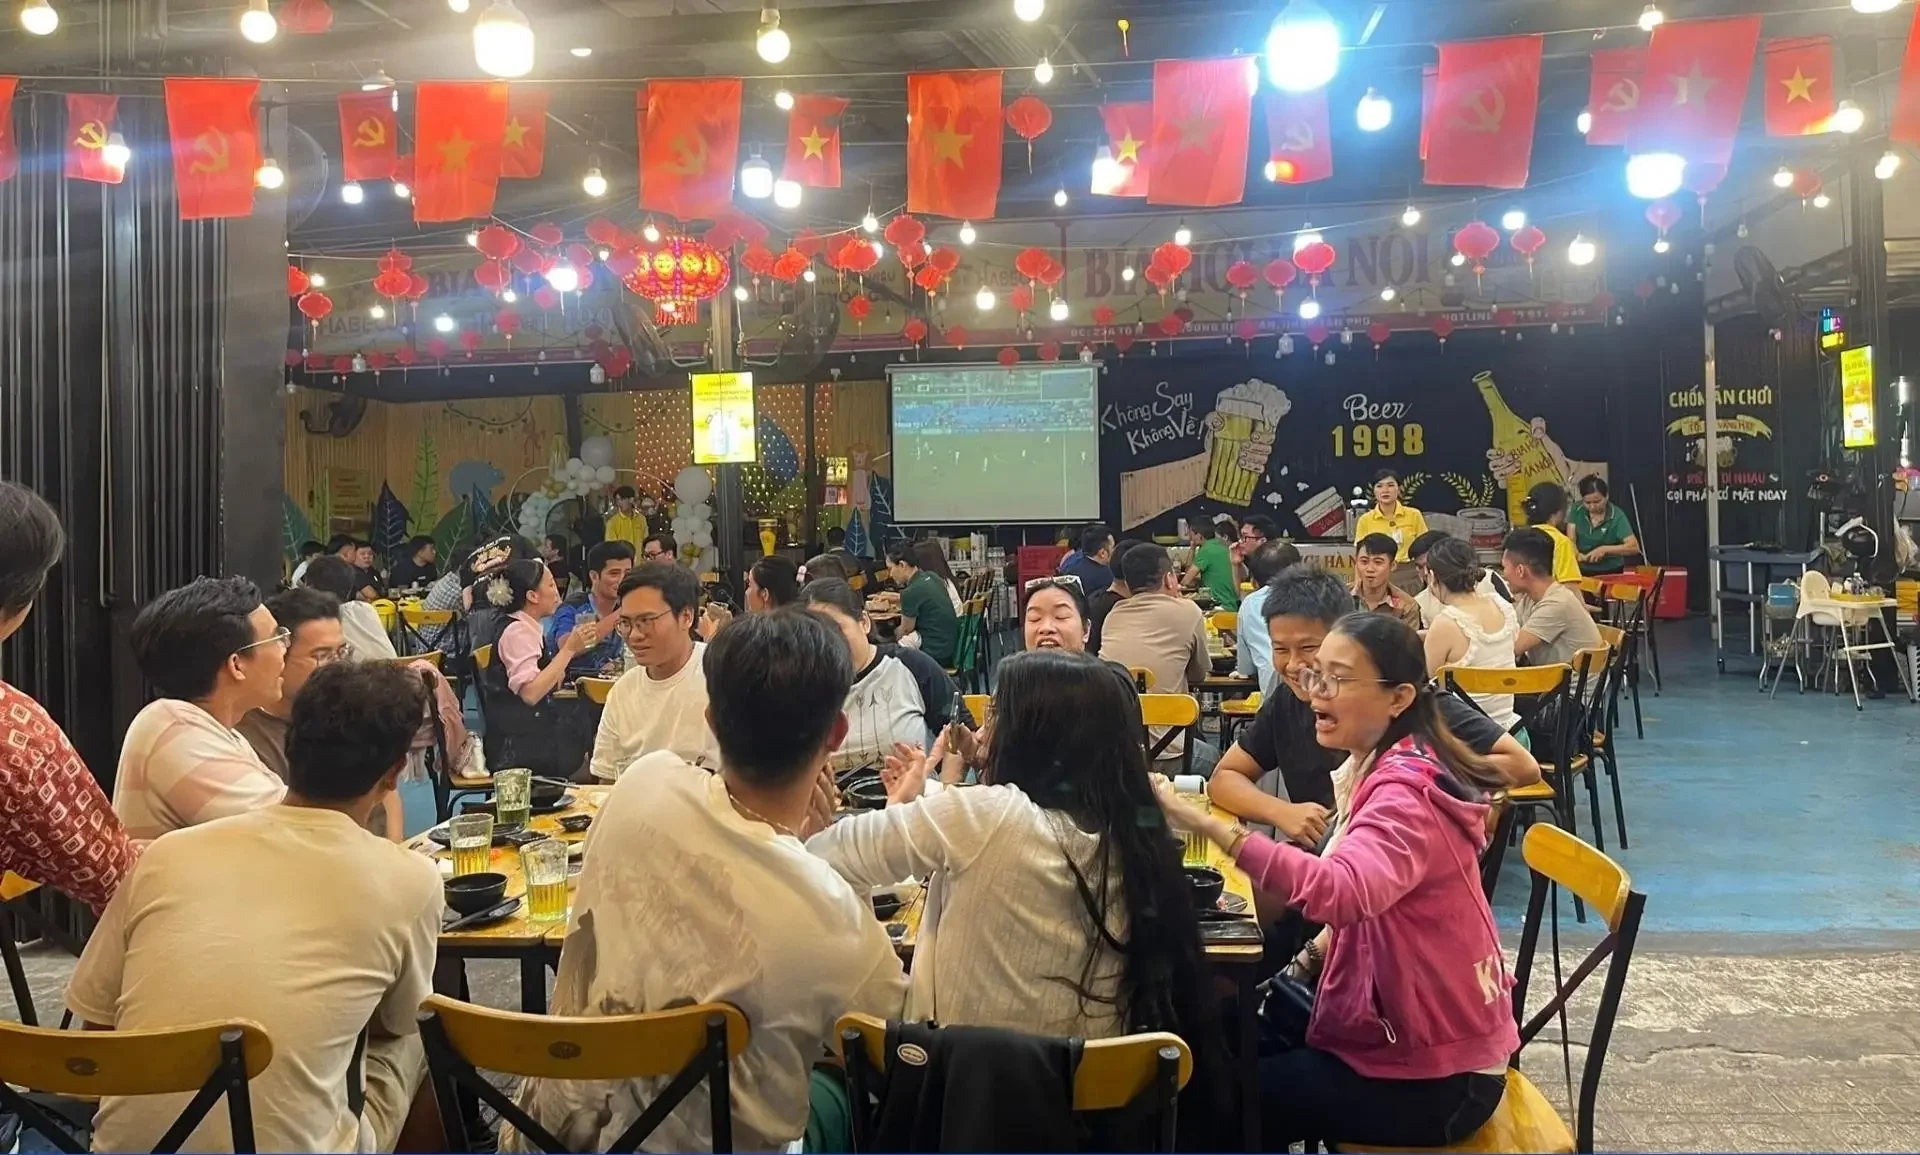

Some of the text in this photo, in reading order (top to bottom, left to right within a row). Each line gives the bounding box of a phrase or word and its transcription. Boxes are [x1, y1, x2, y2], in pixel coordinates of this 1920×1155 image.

[1100, 380, 1193, 435] Không Say
[1343, 393, 1413, 422] Beer
[1739, 385, 1772, 405] CHƠI
[1126, 425, 1177, 455] Không
[1332, 423, 1424, 457] 1998
[1686, 488, 1709, 502] PHÁ
